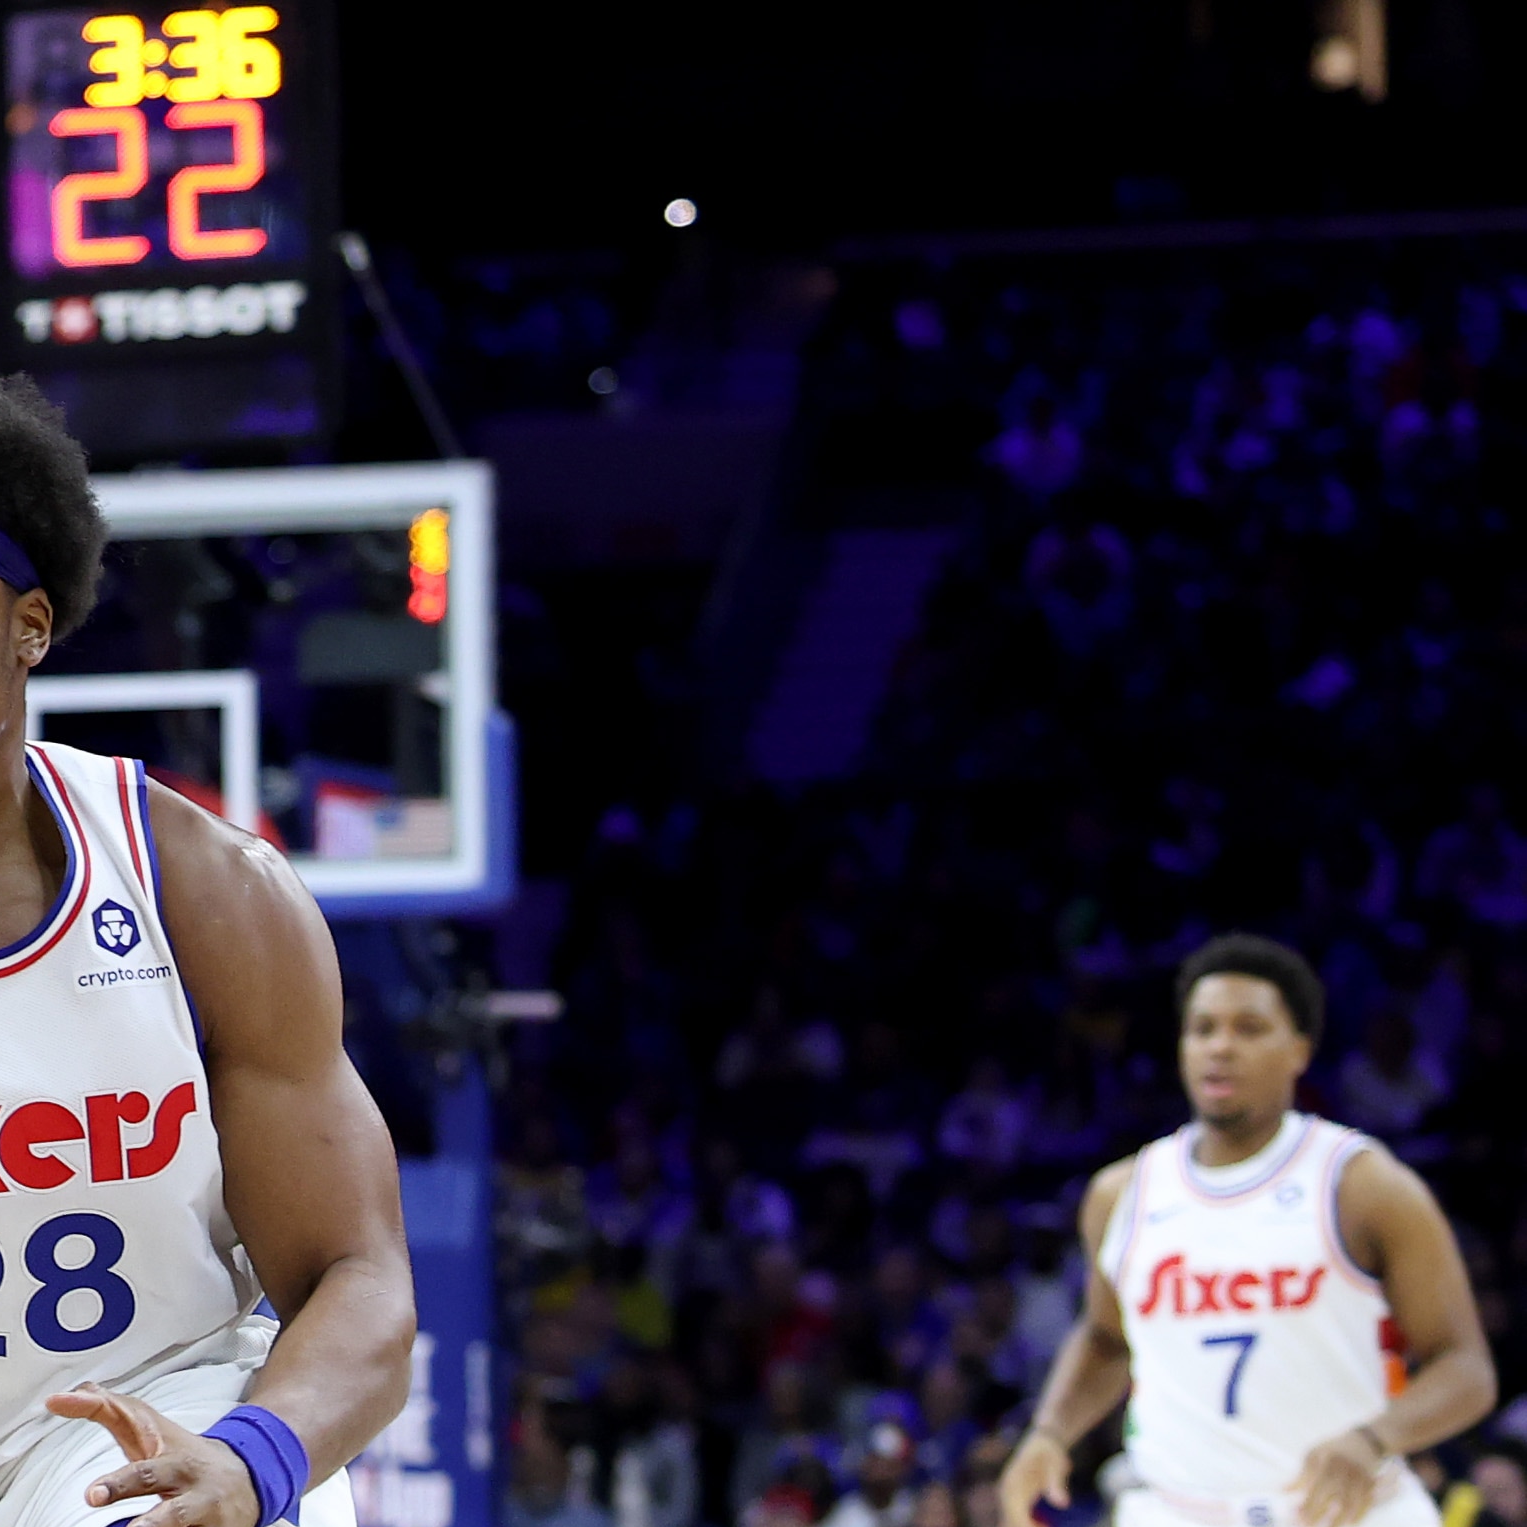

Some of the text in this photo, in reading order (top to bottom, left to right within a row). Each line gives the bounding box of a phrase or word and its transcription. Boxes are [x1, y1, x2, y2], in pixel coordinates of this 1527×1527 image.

[81, 5, 282, 108] 3:36
[49, 98, 269, 268] 22
[93, 280, 308, 342] TISSOT
[77, 964, 172, 988] crypto.com
[1137, 1253, 1328, 1320] Sixers
[1201, 1331, 1260, 1418] 7
